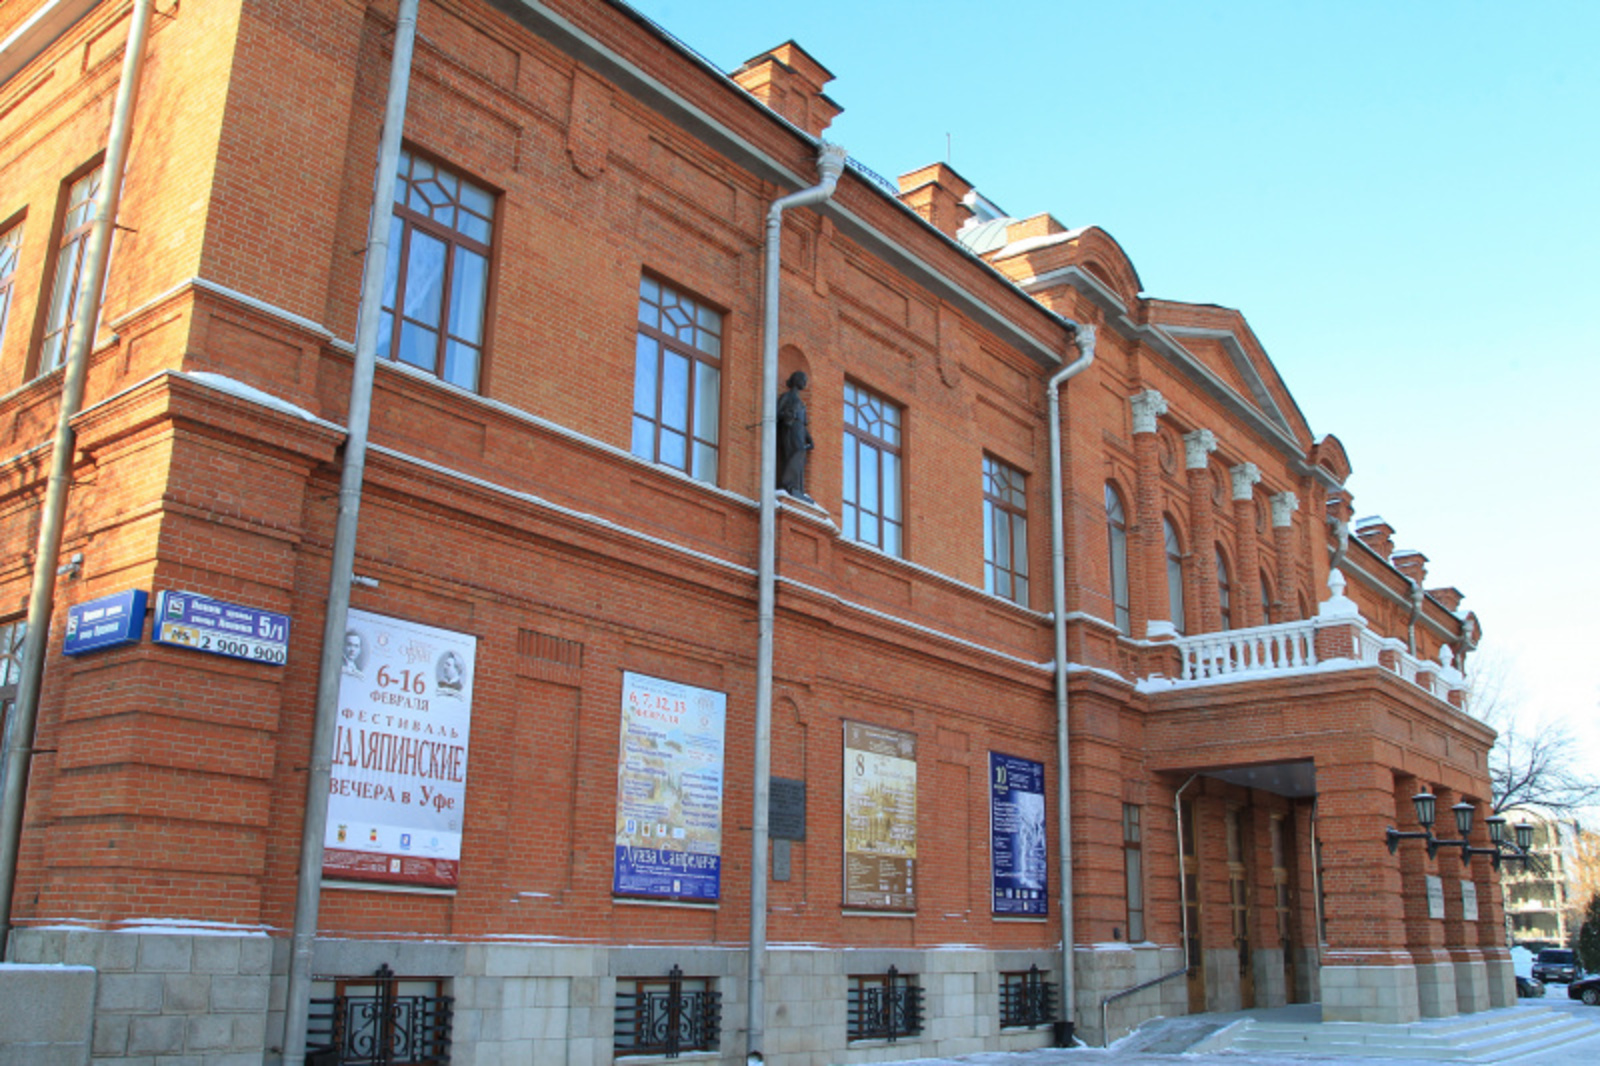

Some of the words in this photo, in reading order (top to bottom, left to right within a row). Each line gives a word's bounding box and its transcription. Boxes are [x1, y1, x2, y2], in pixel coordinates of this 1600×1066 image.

[259, 616, 283, 641] 5/1
[201, 636, 211, 649] 2
[217, 639, 249, 657] 900
[254, 645, 285, 663] 900
[377, 664, 426, 695] 6-16
[369, 690, 429, 712] ФЕВРАЛЯ
[673, 700, 687, 715] 13
[341, 708, 459, 738] ФЕСТИВАЛЬ
[856, 753, 865, 777] 8
[995, 766, 1007, 784] 10
[329, 777, 396, 803] ВЕЧЕРА
[419, 785, 455, 813] Уфе
